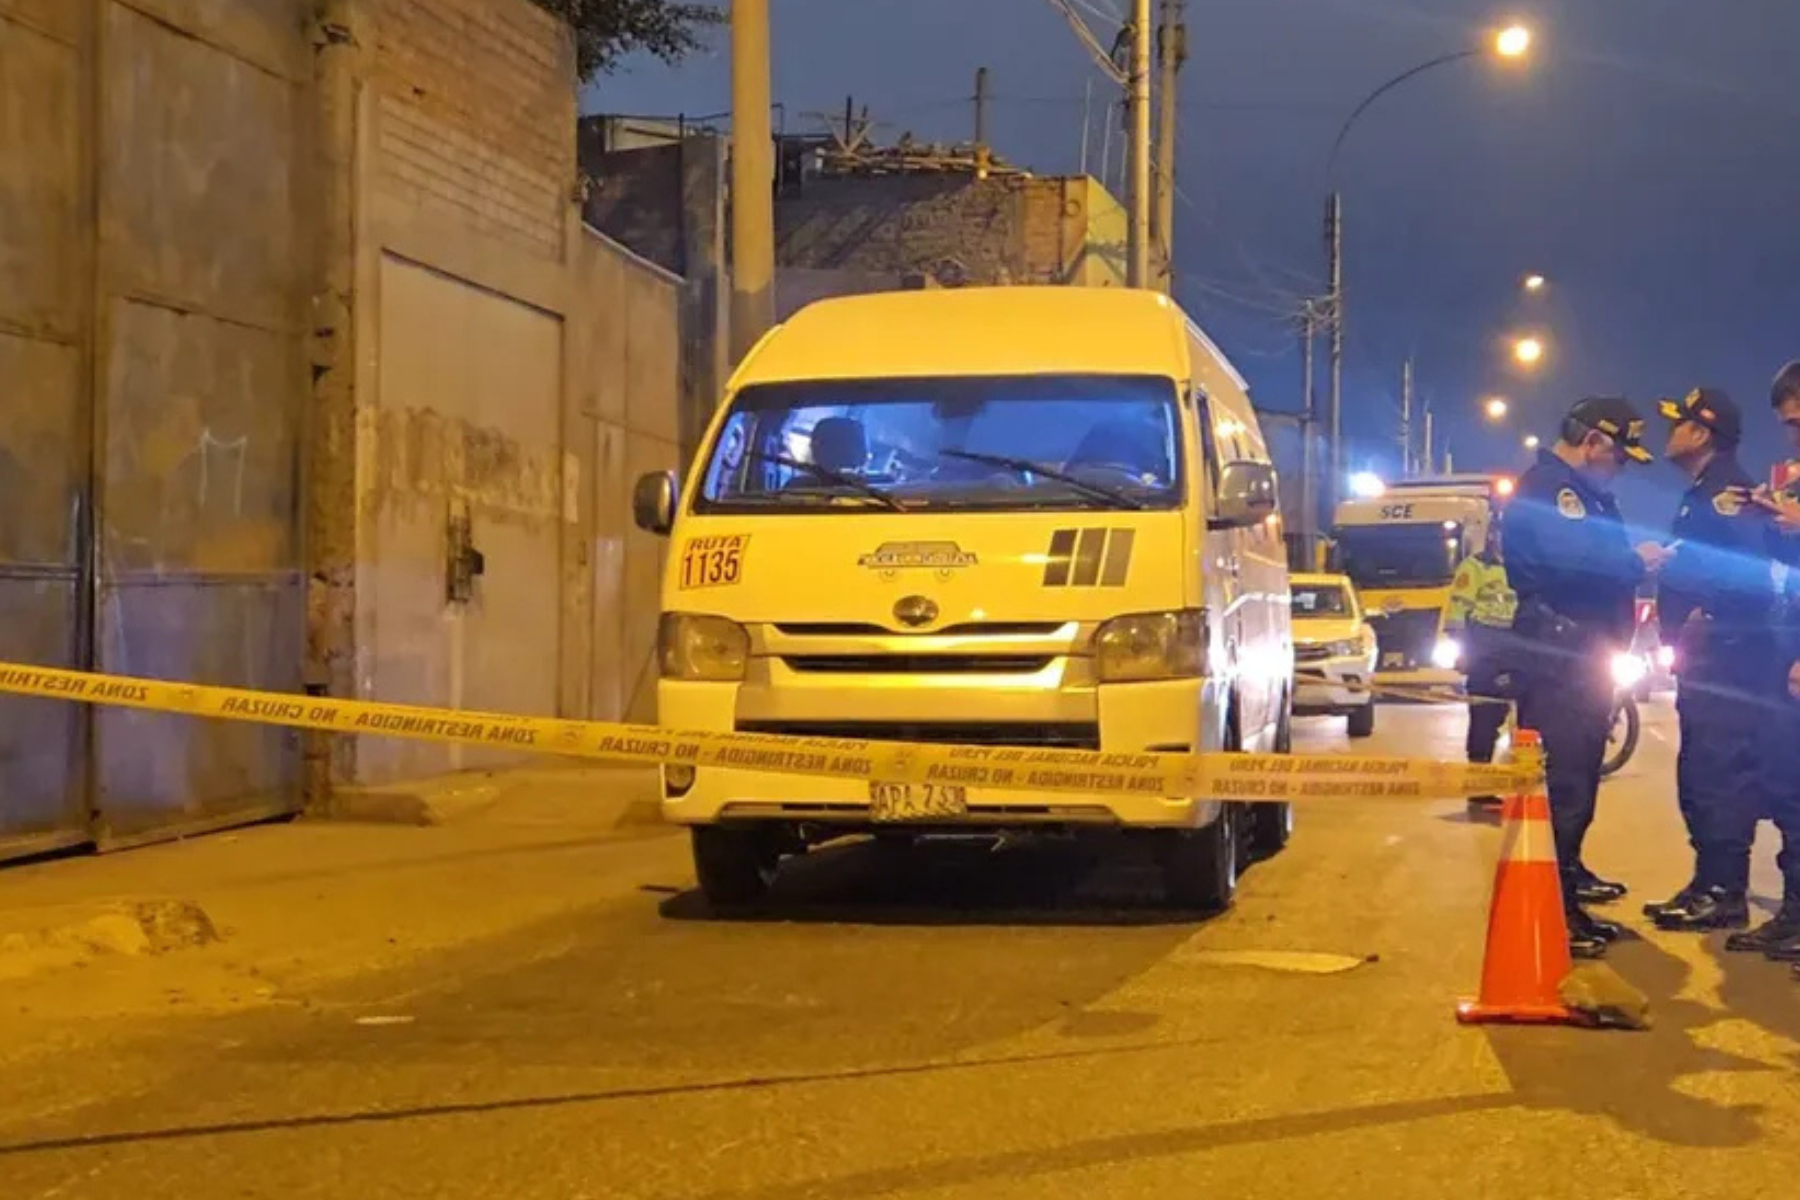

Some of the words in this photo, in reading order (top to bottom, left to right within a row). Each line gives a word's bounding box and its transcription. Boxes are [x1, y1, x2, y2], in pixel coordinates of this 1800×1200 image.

[1380, 503, 1415, 519] SCE
[689, 536, 741, 550] RUTA
[685, 549, 740, 585] 1135
